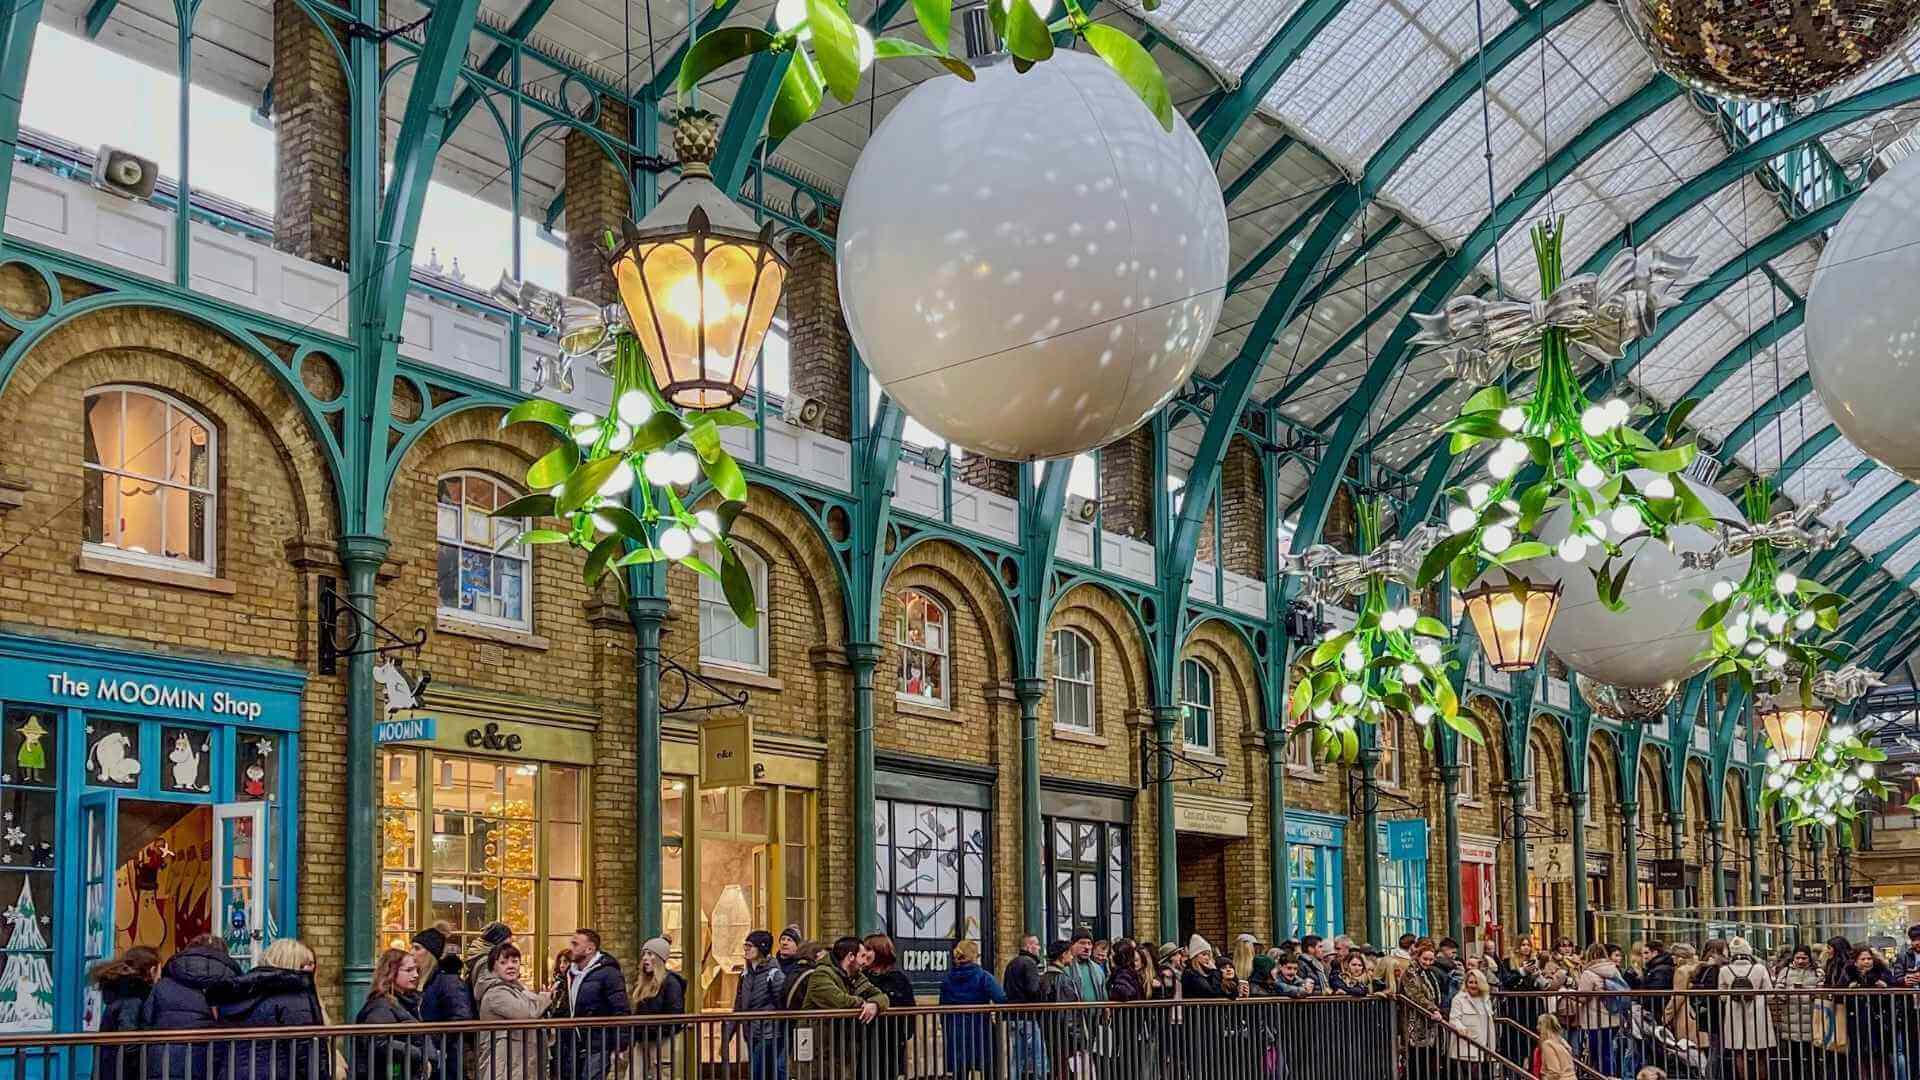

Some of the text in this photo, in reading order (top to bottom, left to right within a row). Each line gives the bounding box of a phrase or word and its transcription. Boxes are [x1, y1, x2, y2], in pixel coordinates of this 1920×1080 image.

[48, 672, 262, 720] The MOOMIN Shop
[378, 721, 424, 742] MOOMIN
[464, 722, 522, 752] e&e
[903, 950, 948, 971] IZIPIZI
